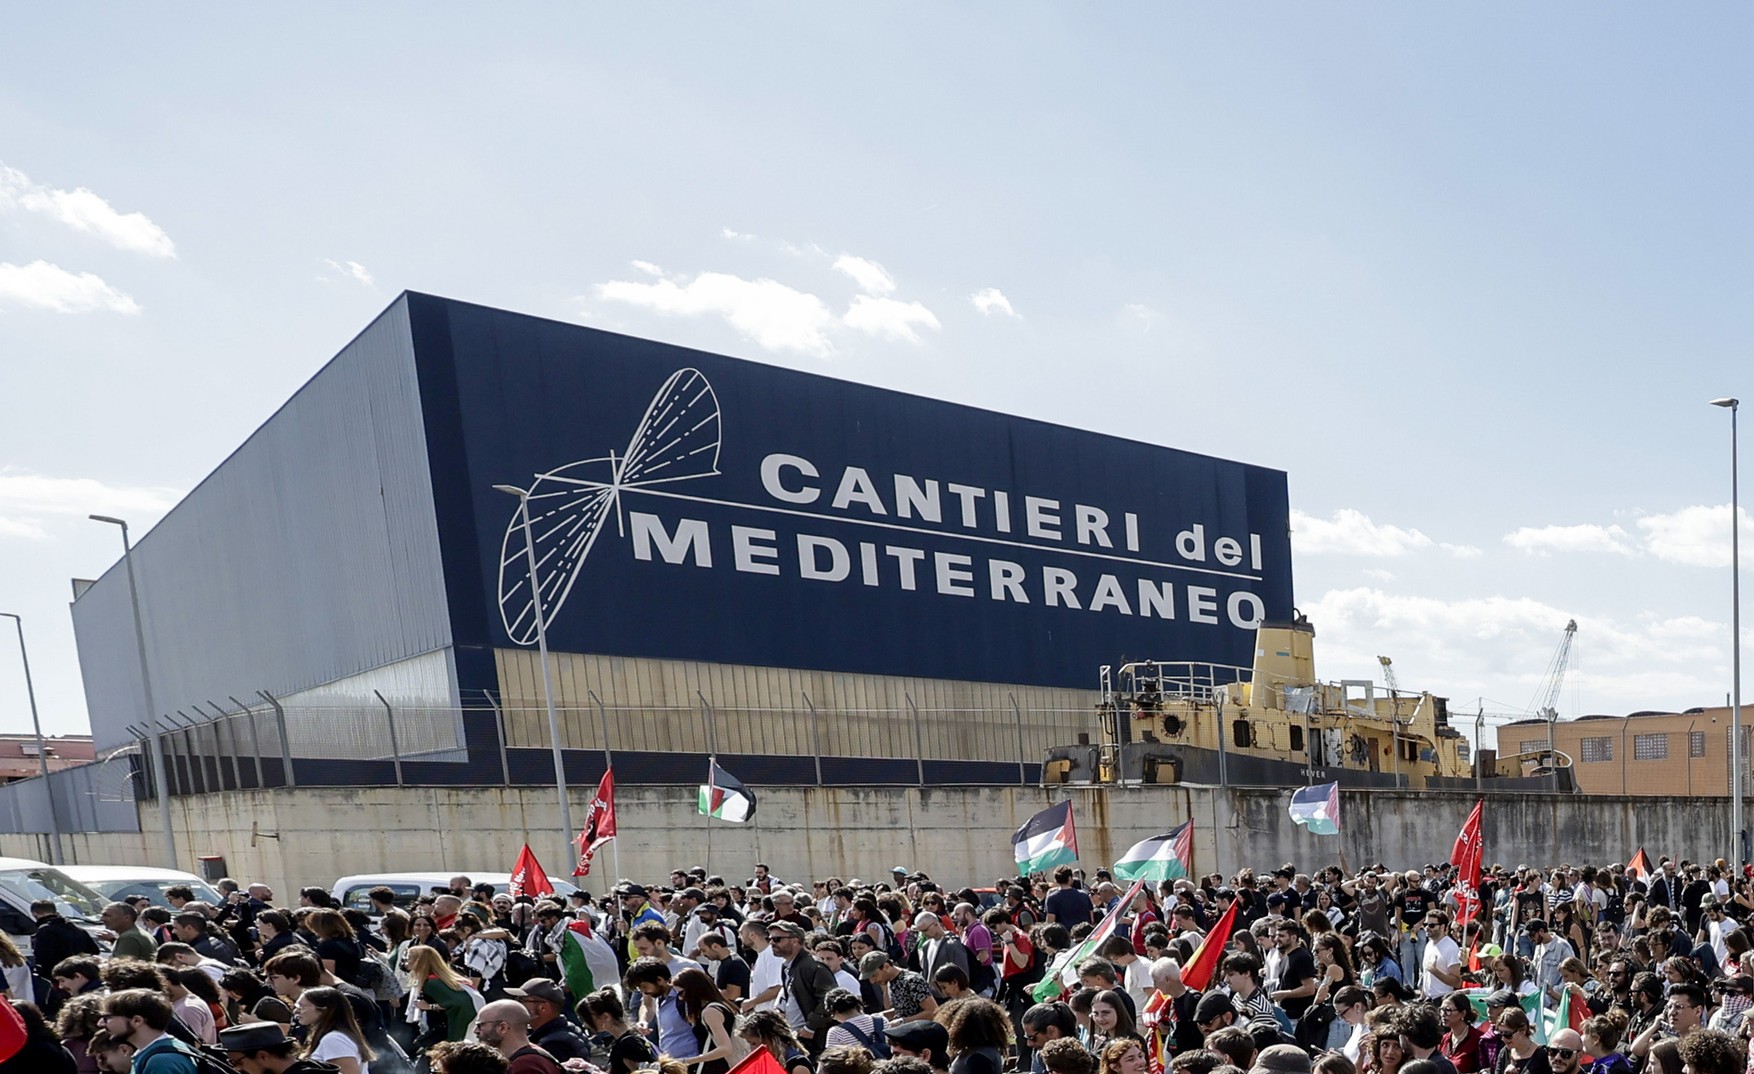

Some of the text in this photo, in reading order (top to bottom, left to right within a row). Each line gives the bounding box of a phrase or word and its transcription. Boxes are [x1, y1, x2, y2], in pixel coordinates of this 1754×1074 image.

[629, 511, 1266, 630] MEDITERRANEO
[760, 452, 1263, 571] CANTIERI del
